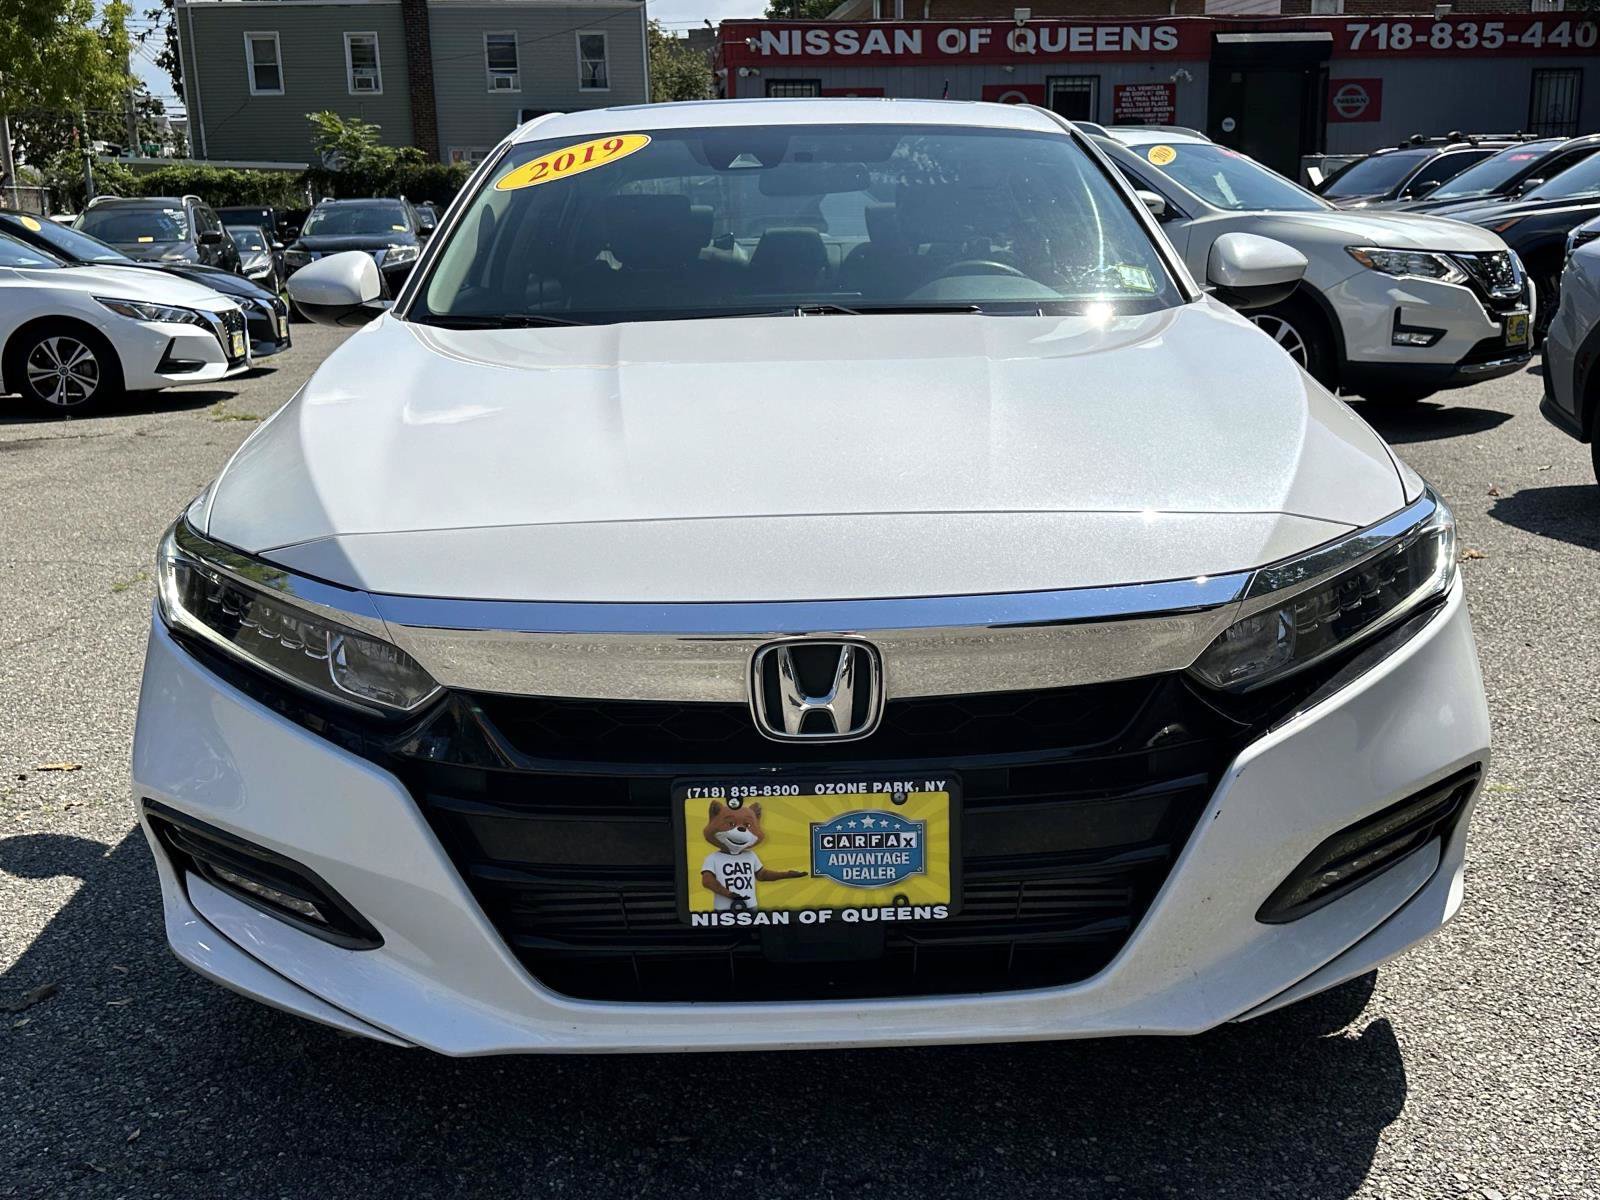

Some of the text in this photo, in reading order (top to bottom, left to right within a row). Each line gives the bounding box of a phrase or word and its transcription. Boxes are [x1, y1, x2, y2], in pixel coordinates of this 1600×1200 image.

[761, 26, 1179, 56] NISSAN OF QUEENS
[1346, 21, 1598, 50] 718-835-440
[528, 138, 624, 182] 2019
[687, 780, 946, 799] (718) 835-8300 OZONE PARK, NY
[821, 832, 917, 849] CARFAX
[828, 852, 910, 866] ADVANTAGE
[722, 862, 753, 876] CAR
[842, 867, 896, 880] DEALER
[724, 876, 753, 891] FOX
[691, 906, 949, 926] NISSAN OF QUEENS
